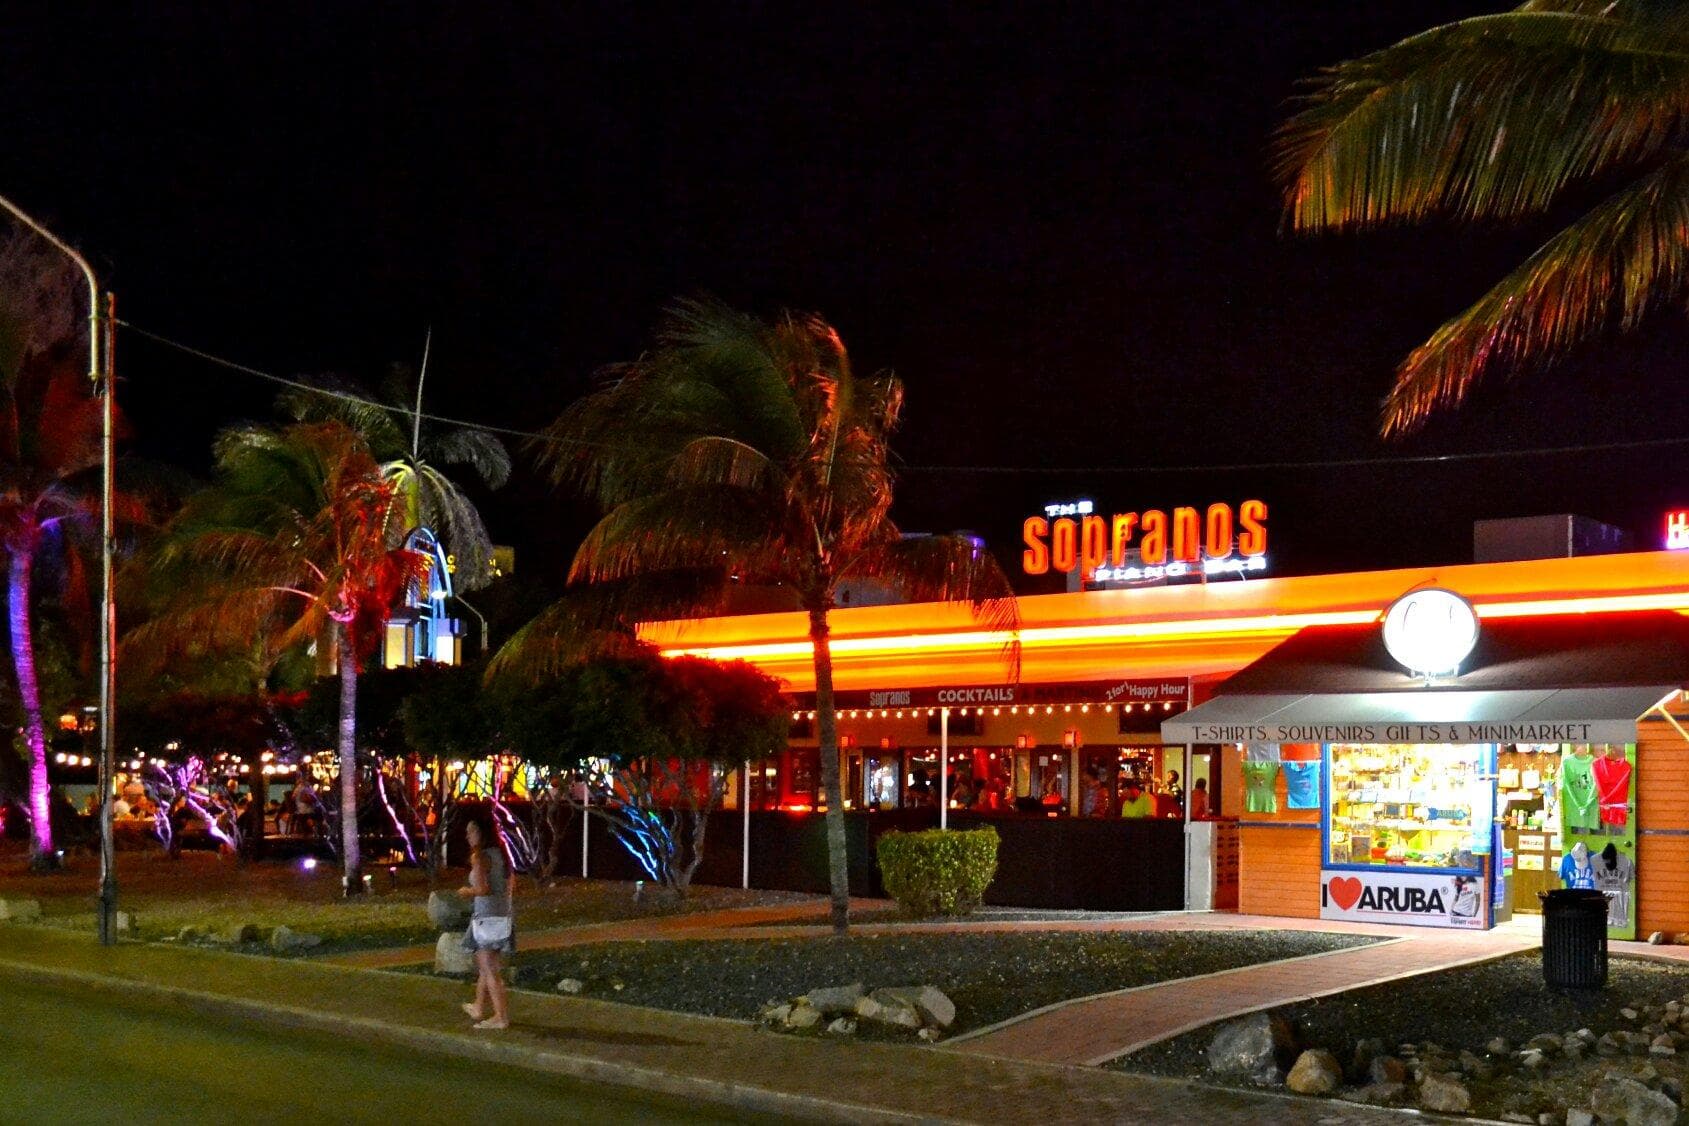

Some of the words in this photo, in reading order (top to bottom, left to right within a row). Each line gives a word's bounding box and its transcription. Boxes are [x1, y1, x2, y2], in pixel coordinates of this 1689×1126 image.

[1023, 499, 1268, 581] Sopranos
[870, 690, 911, 707] Sopranos
[938, 688, 1014, 702] COCKTAILS
[1129, 684, 1159, 698] Happy
[1161, 683, 1186, 695] Hour
[1278, 725, 1375, 741] SOUVENIRS
[1386, 725, 1440, 741] GIFTS
[1448, 725, 1459, 741] &
[1469, 724, 1592, 740] MINIMARKET
[1322, 884, 1328, 907] I
